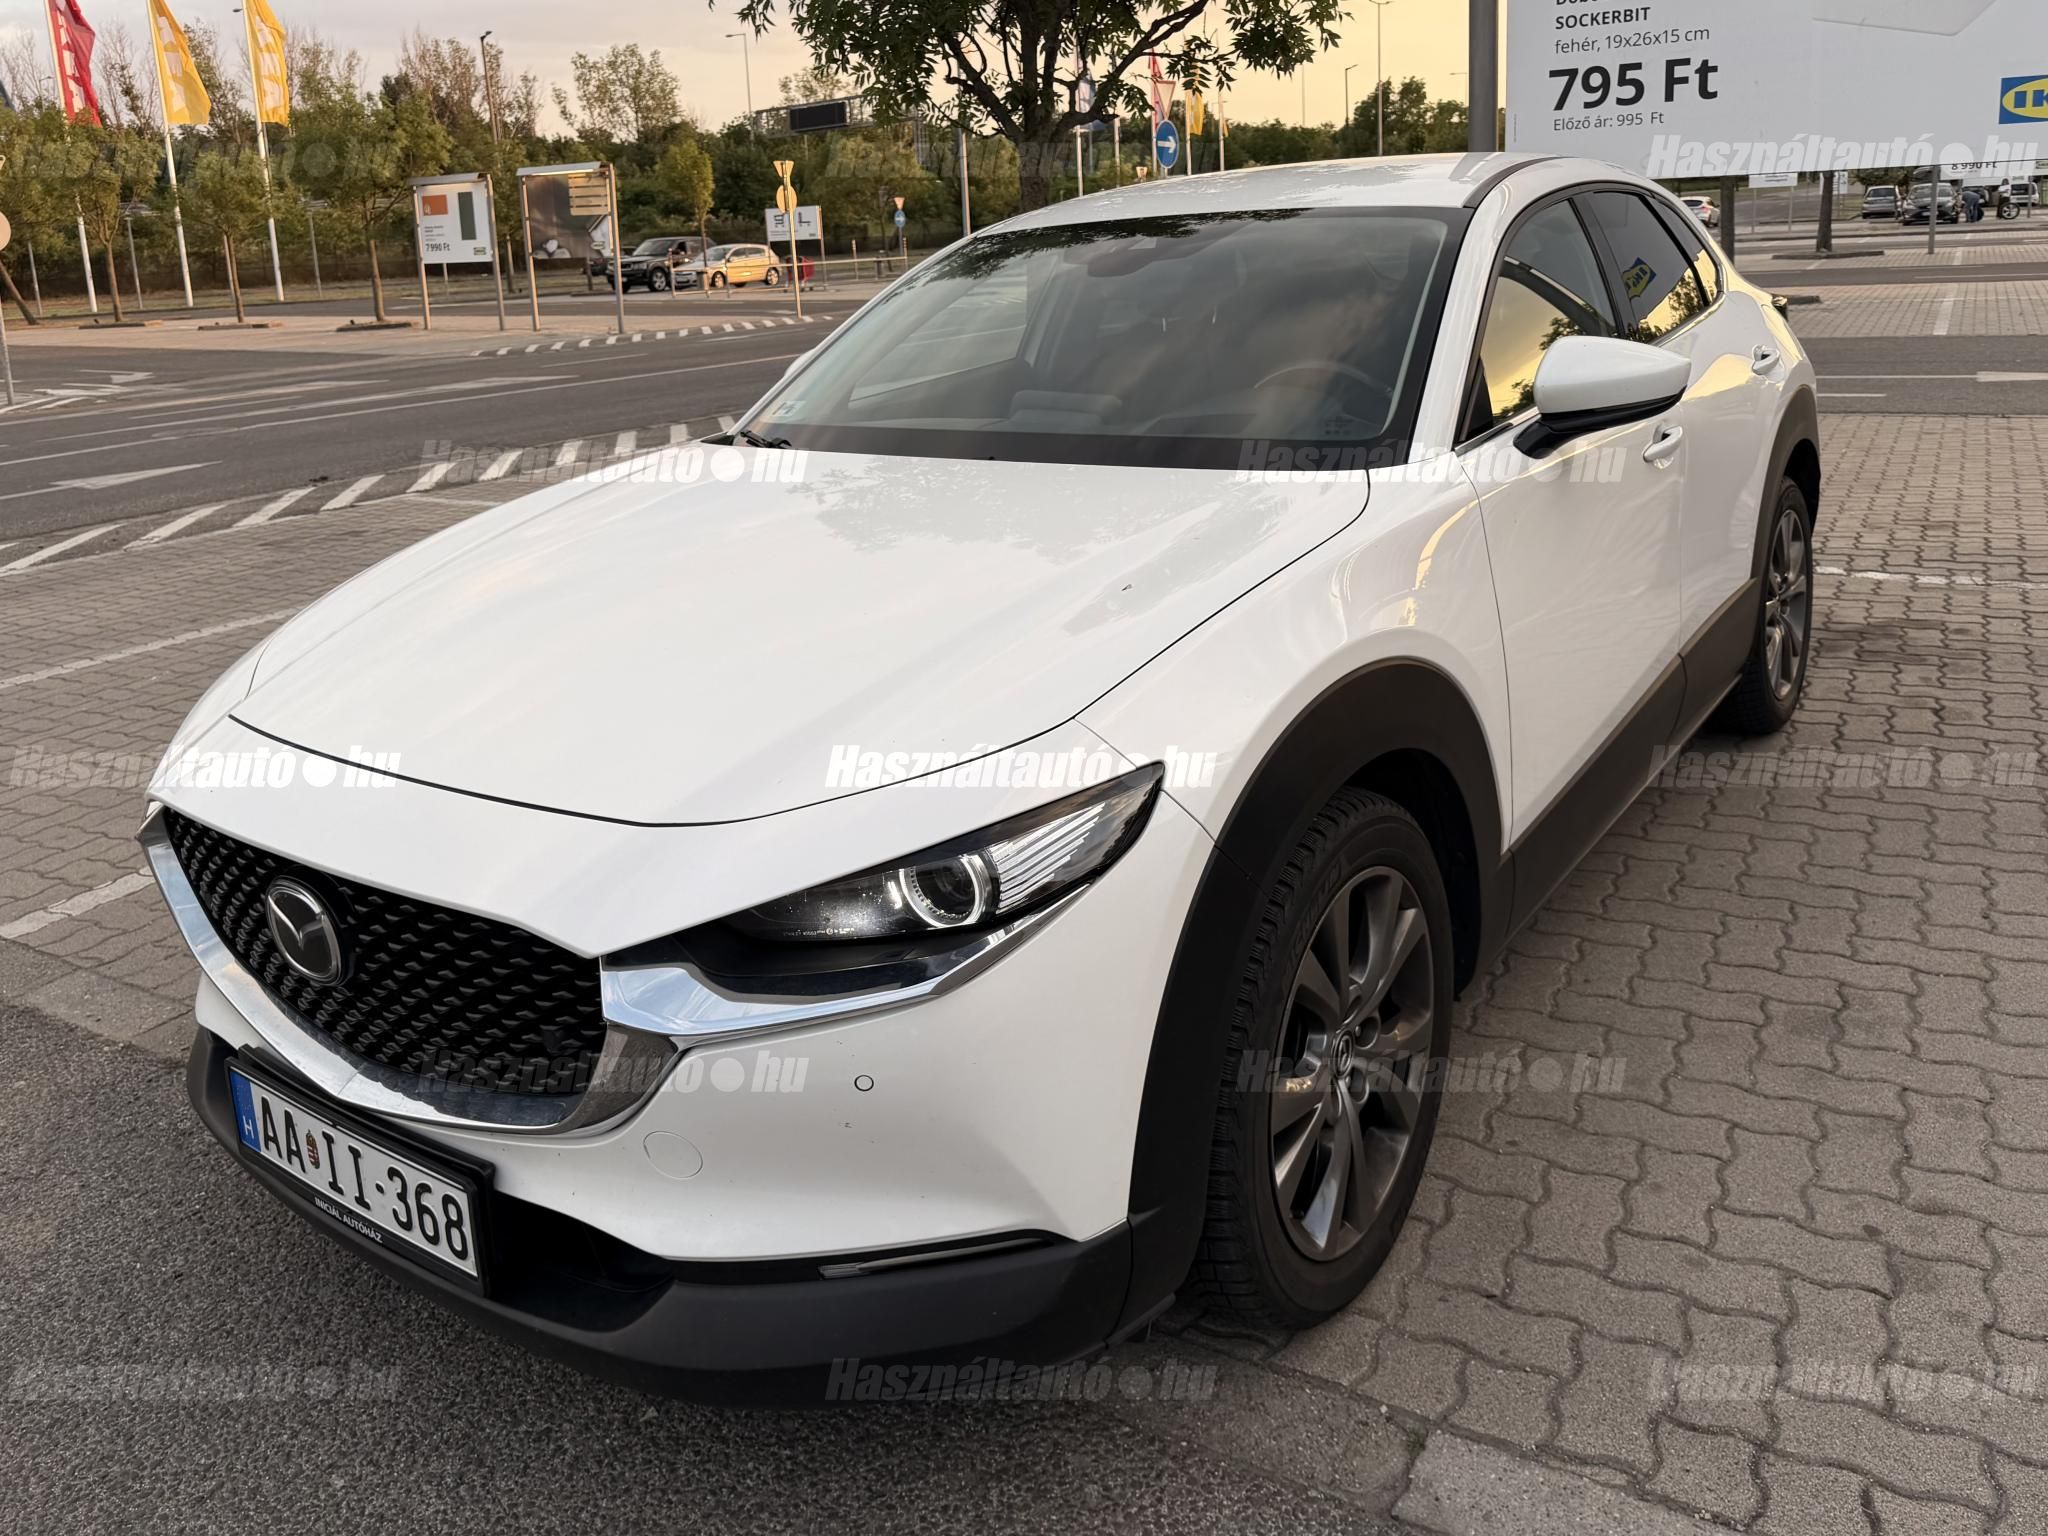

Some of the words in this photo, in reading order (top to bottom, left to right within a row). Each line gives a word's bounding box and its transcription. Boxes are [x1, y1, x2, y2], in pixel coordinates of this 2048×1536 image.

[1555, 7, 1651, 30] SOCKERBIT
[1555, 37, 1601, 54] fehér,
[1605, 29, 1681, 49] 19x26x15
[1685, 28, 1710, 42] cm
[1549, 62, 1645, 111] 795
[1664, 58, 1719, 102] Ft
[1553, 115, 1591, 131] Előző
[1594, 115, 1613, 129] ár:
[1617, 113, 1643, 127] 995
[1650, 111, 1665, 124] Ft
[243, 1119, 255, 1139] H
[343, 1214, 383, 1244] AUTÓHÁZ
